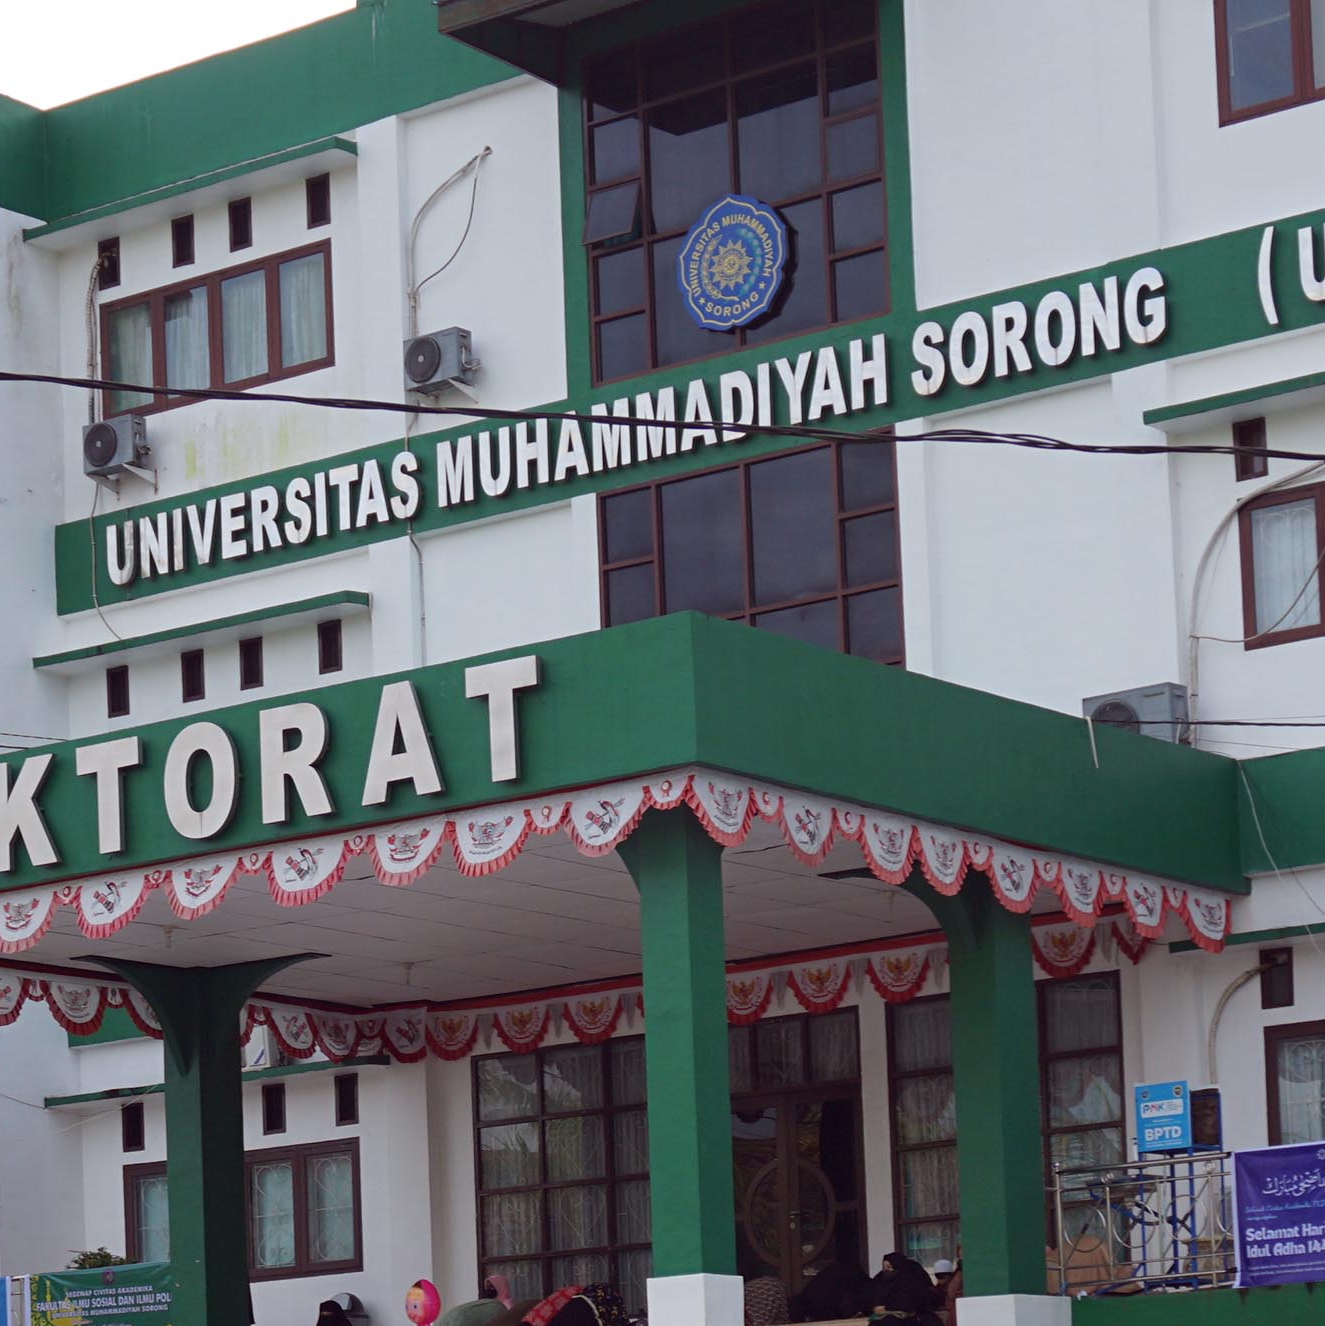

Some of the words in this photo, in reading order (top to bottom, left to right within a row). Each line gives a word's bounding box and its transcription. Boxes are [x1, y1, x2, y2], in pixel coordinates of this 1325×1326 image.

[689, 222, 721, 296] UNIVERSITAS
[721, 213, 775, 278] MUHAMMADIYAH
[705, 290, 759, 317] SORONG
[106, 450, 420, 586] UNIVERSITAS
[436, 333, 889, 508] MUHAMMADIYAH
[910, 266, 1168, 397] SORONG
[1144, 1125, 1182, 1141] BPTD
[1245, 1226, 1300, 1241] Selamat
[1246, 1244, 1272, 1258] Idul
[1273, 1241, 1306, 1257] Adha
[93, 1288, 116, 1296] CIVITAS
[117, 1285, 153, 1294] AKADEMIKA
[36, 1300, 72, 1312] FAKULTAS
[74, 1299, 91, 1309] ILMU
[91, 1296, 117, 1308] SOSIAL
[118, 1295, 135, 1306] DAN
[136, 1294, 155, 1305] ILMU
[156, 1292, 171, 1302] POL
[90, 1307, 140, 1317] MUHAMMADIYAH
[141, 1304, 169, 1312] SORONG
